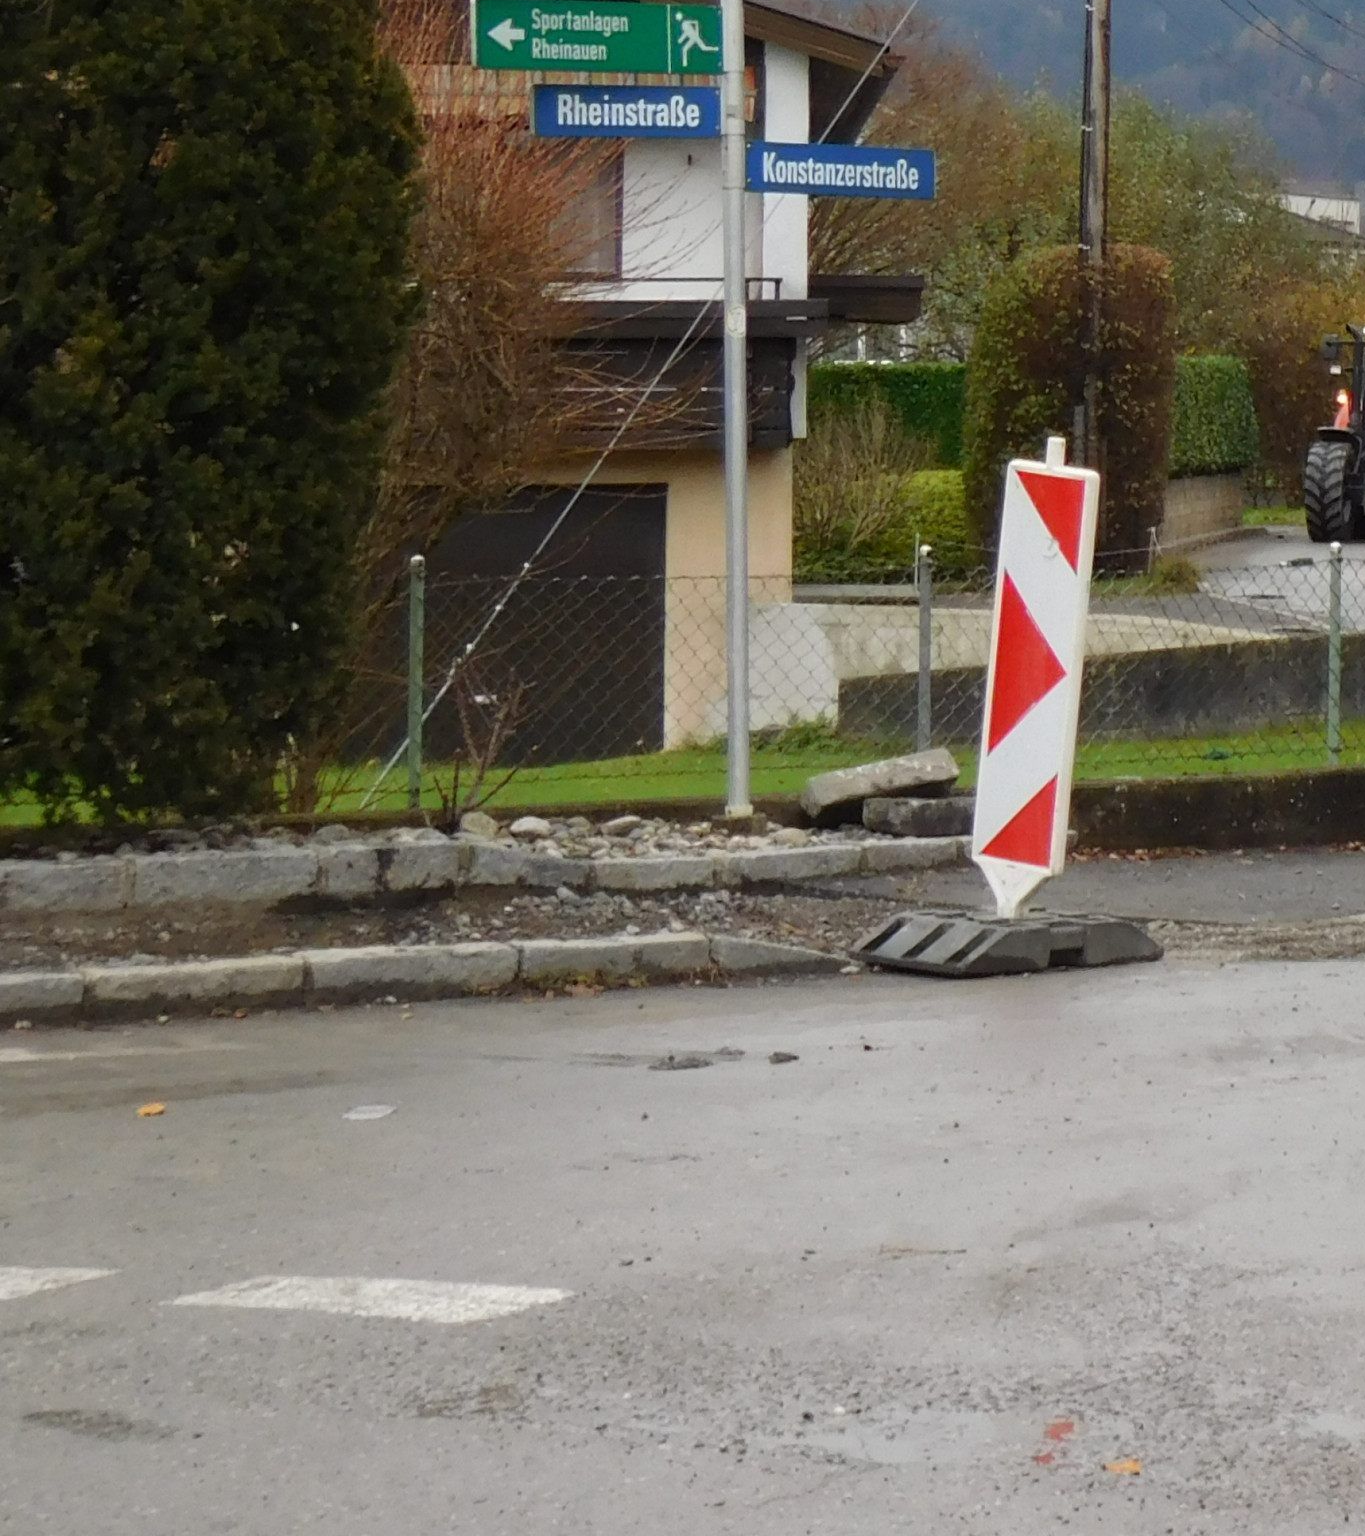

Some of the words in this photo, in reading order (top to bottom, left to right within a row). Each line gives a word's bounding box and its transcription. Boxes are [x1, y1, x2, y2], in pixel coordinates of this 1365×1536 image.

[531, 8, 629, 37] Sportanlagen
[532, 38, 608, 61] Rheinauen
[557, 93, 701, 128] Rheinstraße
[762, 151, 919, 190] Konstanzerstraße
